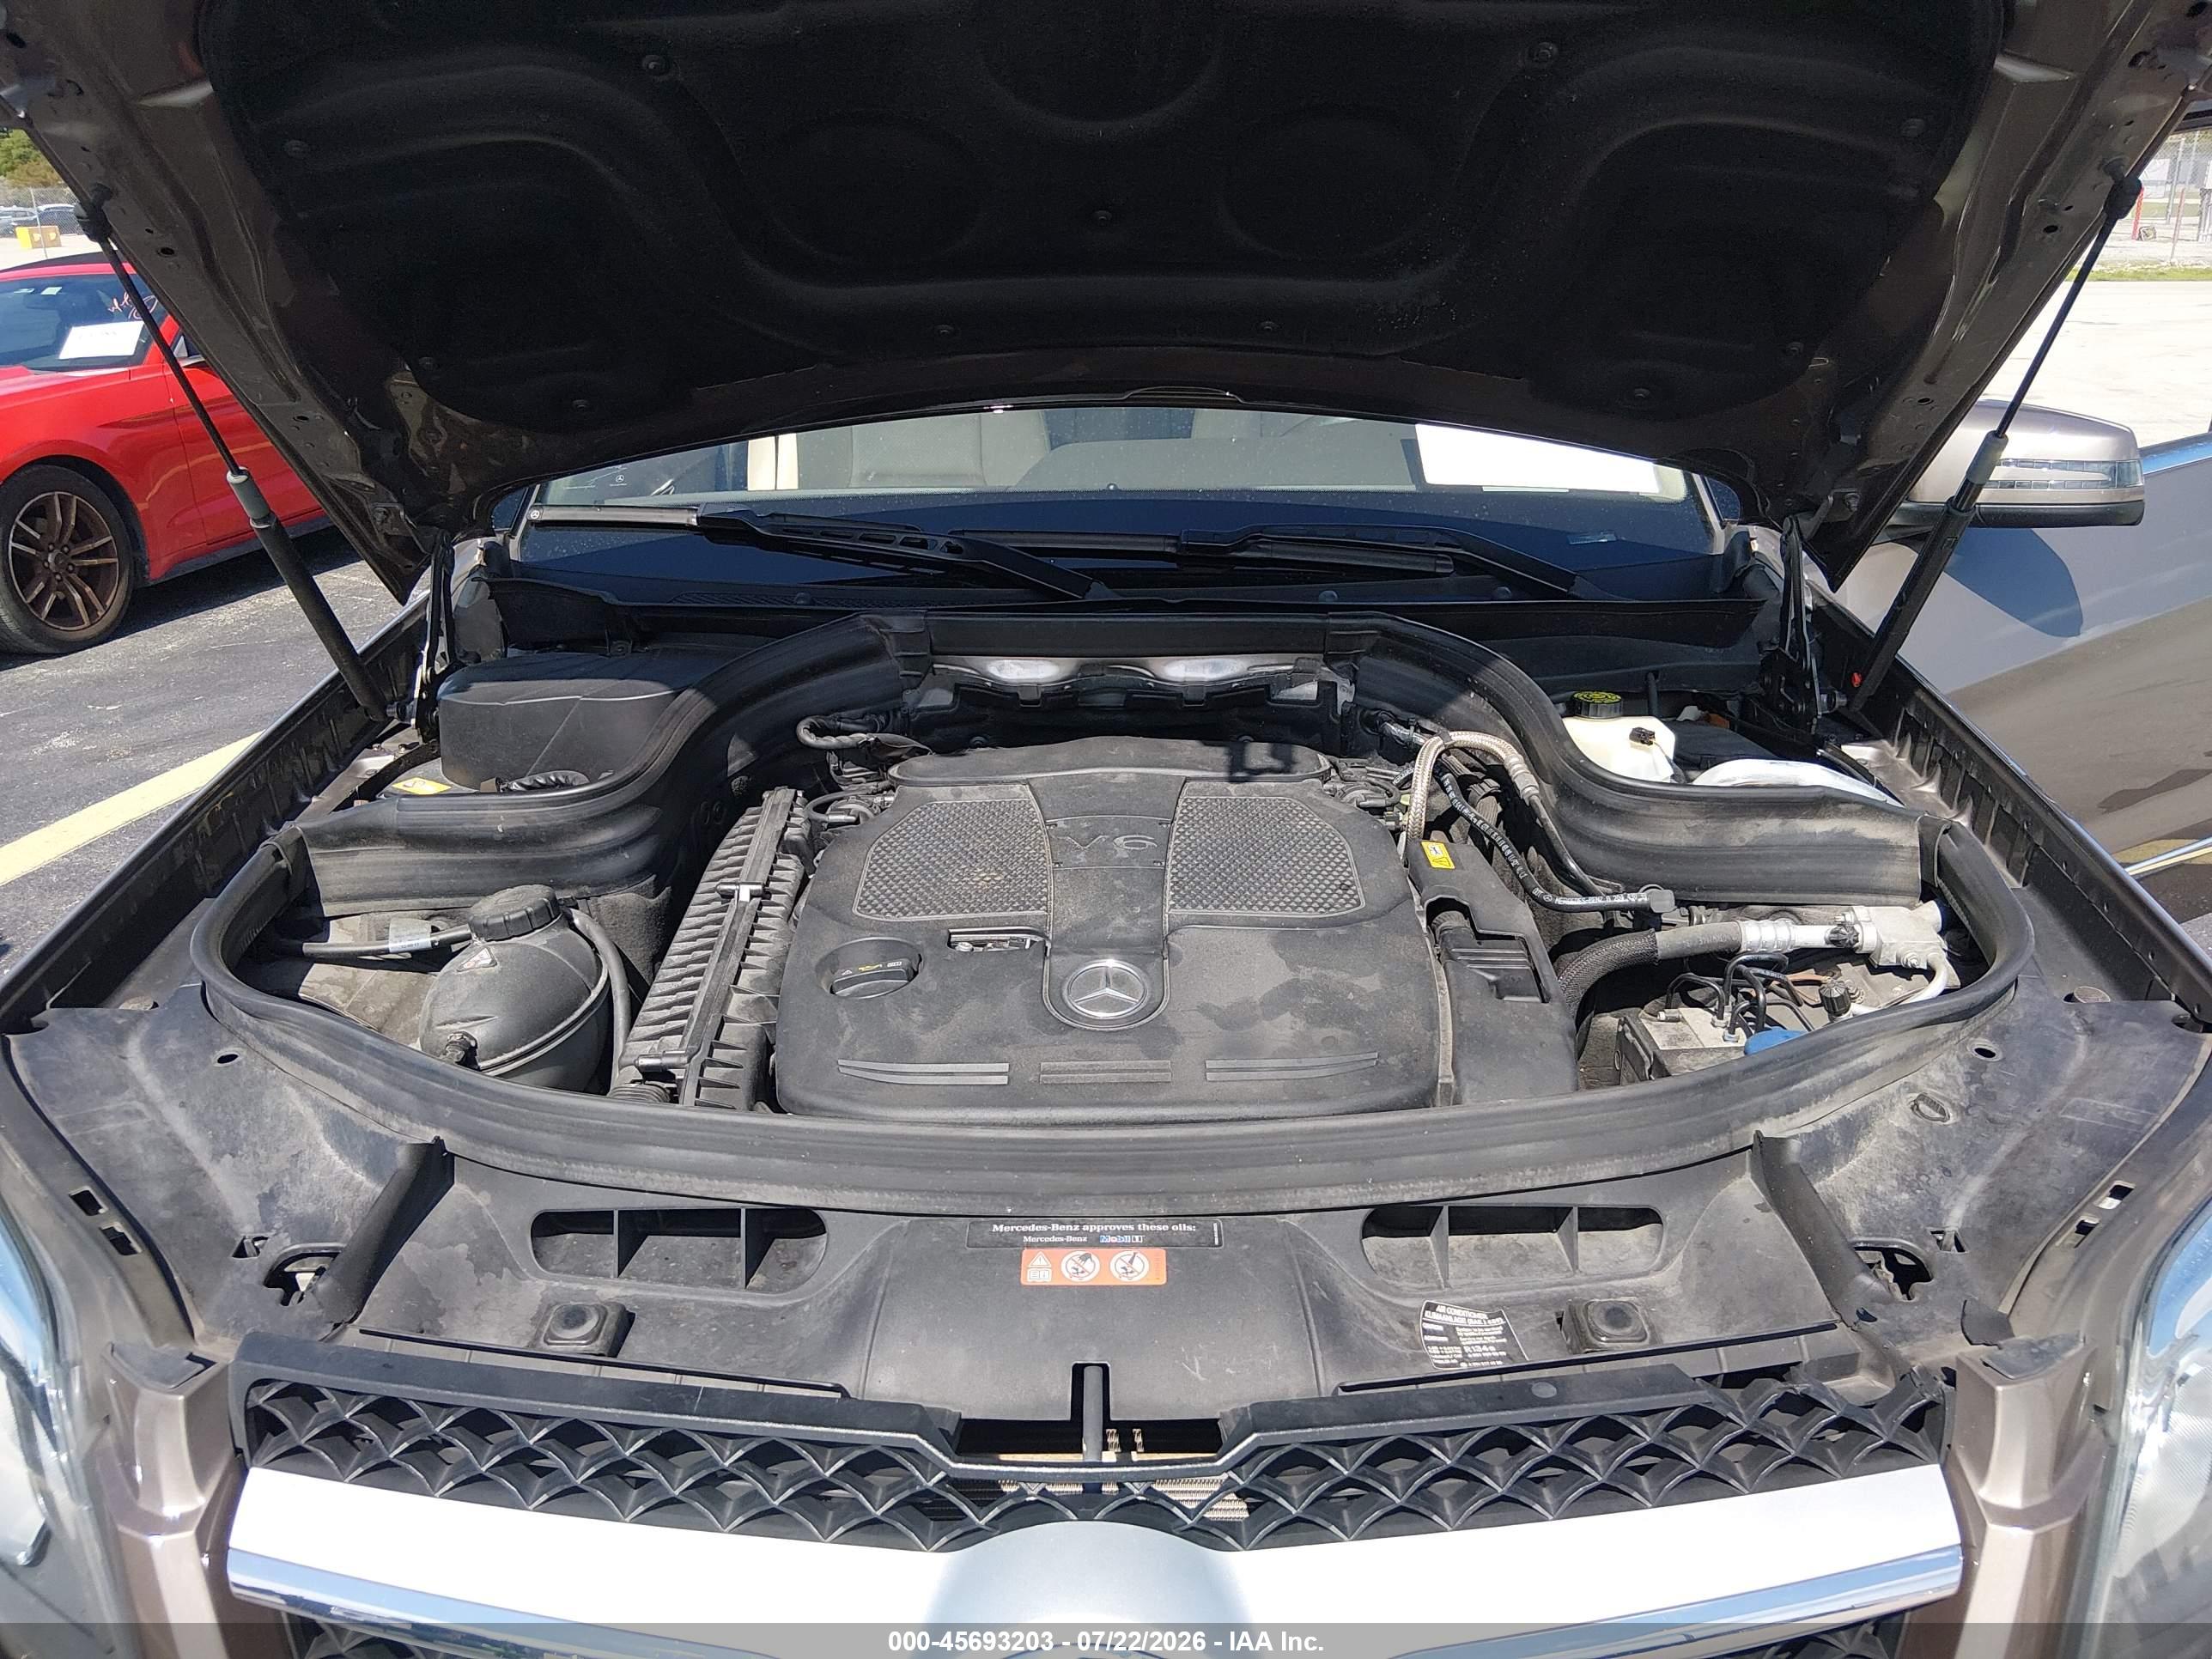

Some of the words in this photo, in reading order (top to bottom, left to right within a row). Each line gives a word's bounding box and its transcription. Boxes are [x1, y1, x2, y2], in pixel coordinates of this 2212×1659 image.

[1059, 834, 1158, 853] V6
[992, 1223, 1079, 1232] Mercedes-Benz
[1082, 1224, 1134, 1233] approves
[1138, 1223, 1169, 1231] these
[1171, 1223, 1196, 1231] oils:
